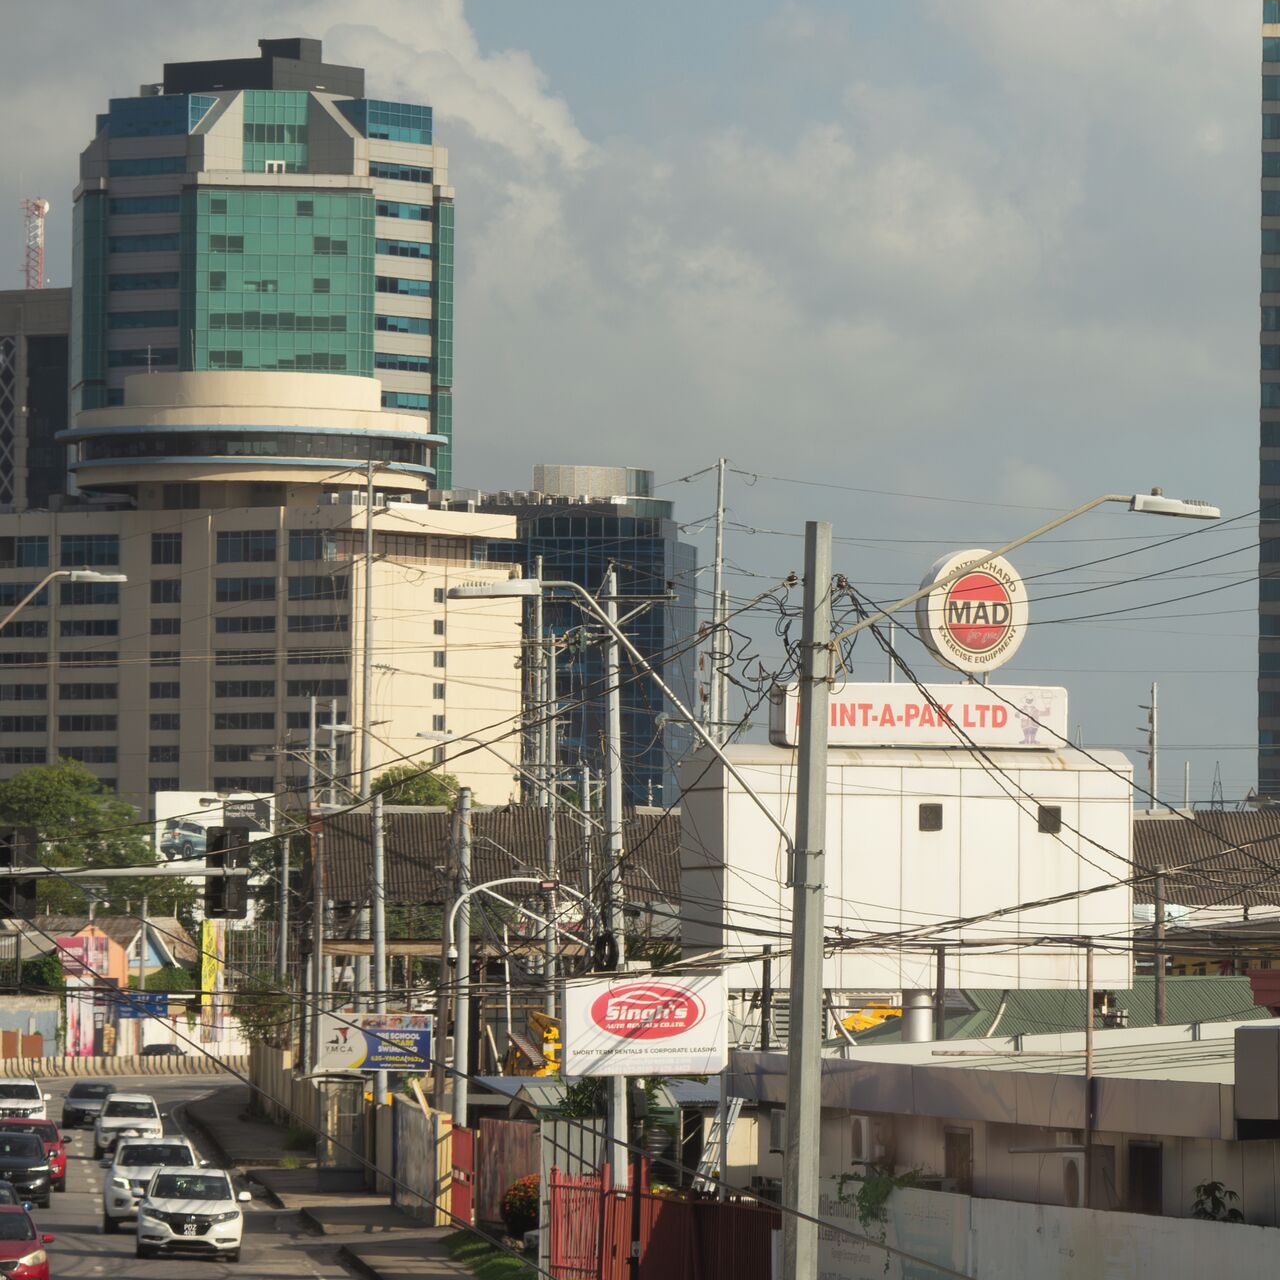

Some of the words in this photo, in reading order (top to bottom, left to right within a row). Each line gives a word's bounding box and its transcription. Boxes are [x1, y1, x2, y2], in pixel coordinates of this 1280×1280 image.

[948, 601, 1010, 625] MAD
[938, 624, 974, 663] EXERCISE
[974, 624, 1018, 664] EQUIPMENT
[963, 703, 1008, 729] LTD
[605, 1004, 688, 1022] Singh's
[325, 1045, 353, 1057] YMCA
